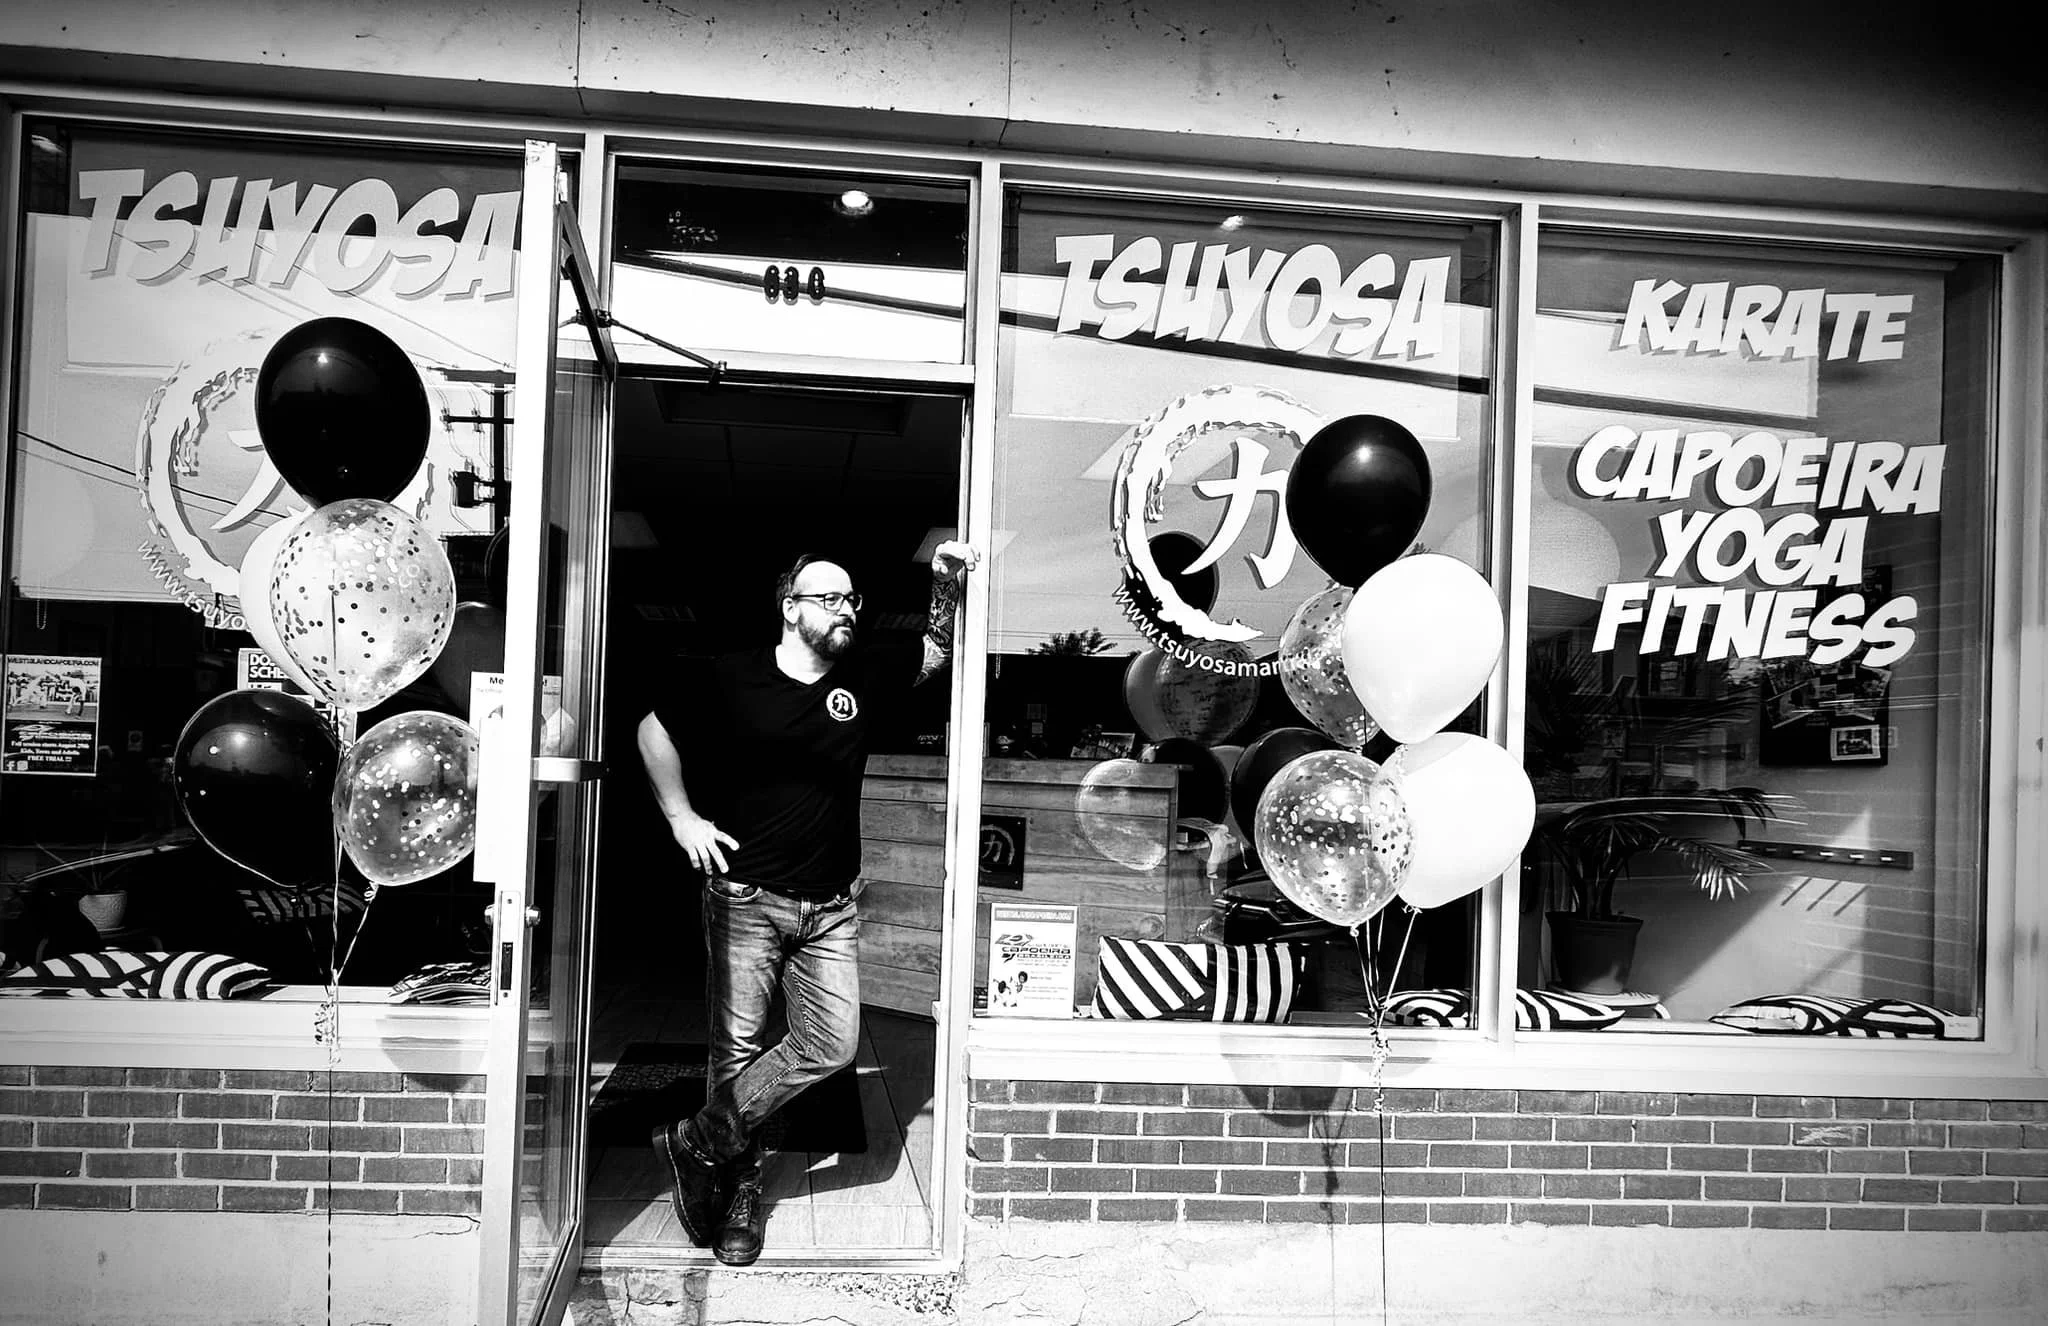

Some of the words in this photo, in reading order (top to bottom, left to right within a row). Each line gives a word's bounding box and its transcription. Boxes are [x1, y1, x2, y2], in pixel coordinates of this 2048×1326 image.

[79, 168, 522, 300] TSUYOSA
[1055, 236, 1452, 358] TSUYOSA
[1616, 279, 1914, 363] KARATE
[1573, 424, 1947, 515] CAPOEIRA
[138, 540, 249, 631] www.tsuyo
[1650, 506, 1870, 587] YOGA
[249, 653, 276, 667] DO
[1591, 581, 1918, 668] FITNESS
[249, 666, 290, 679] SCHE
